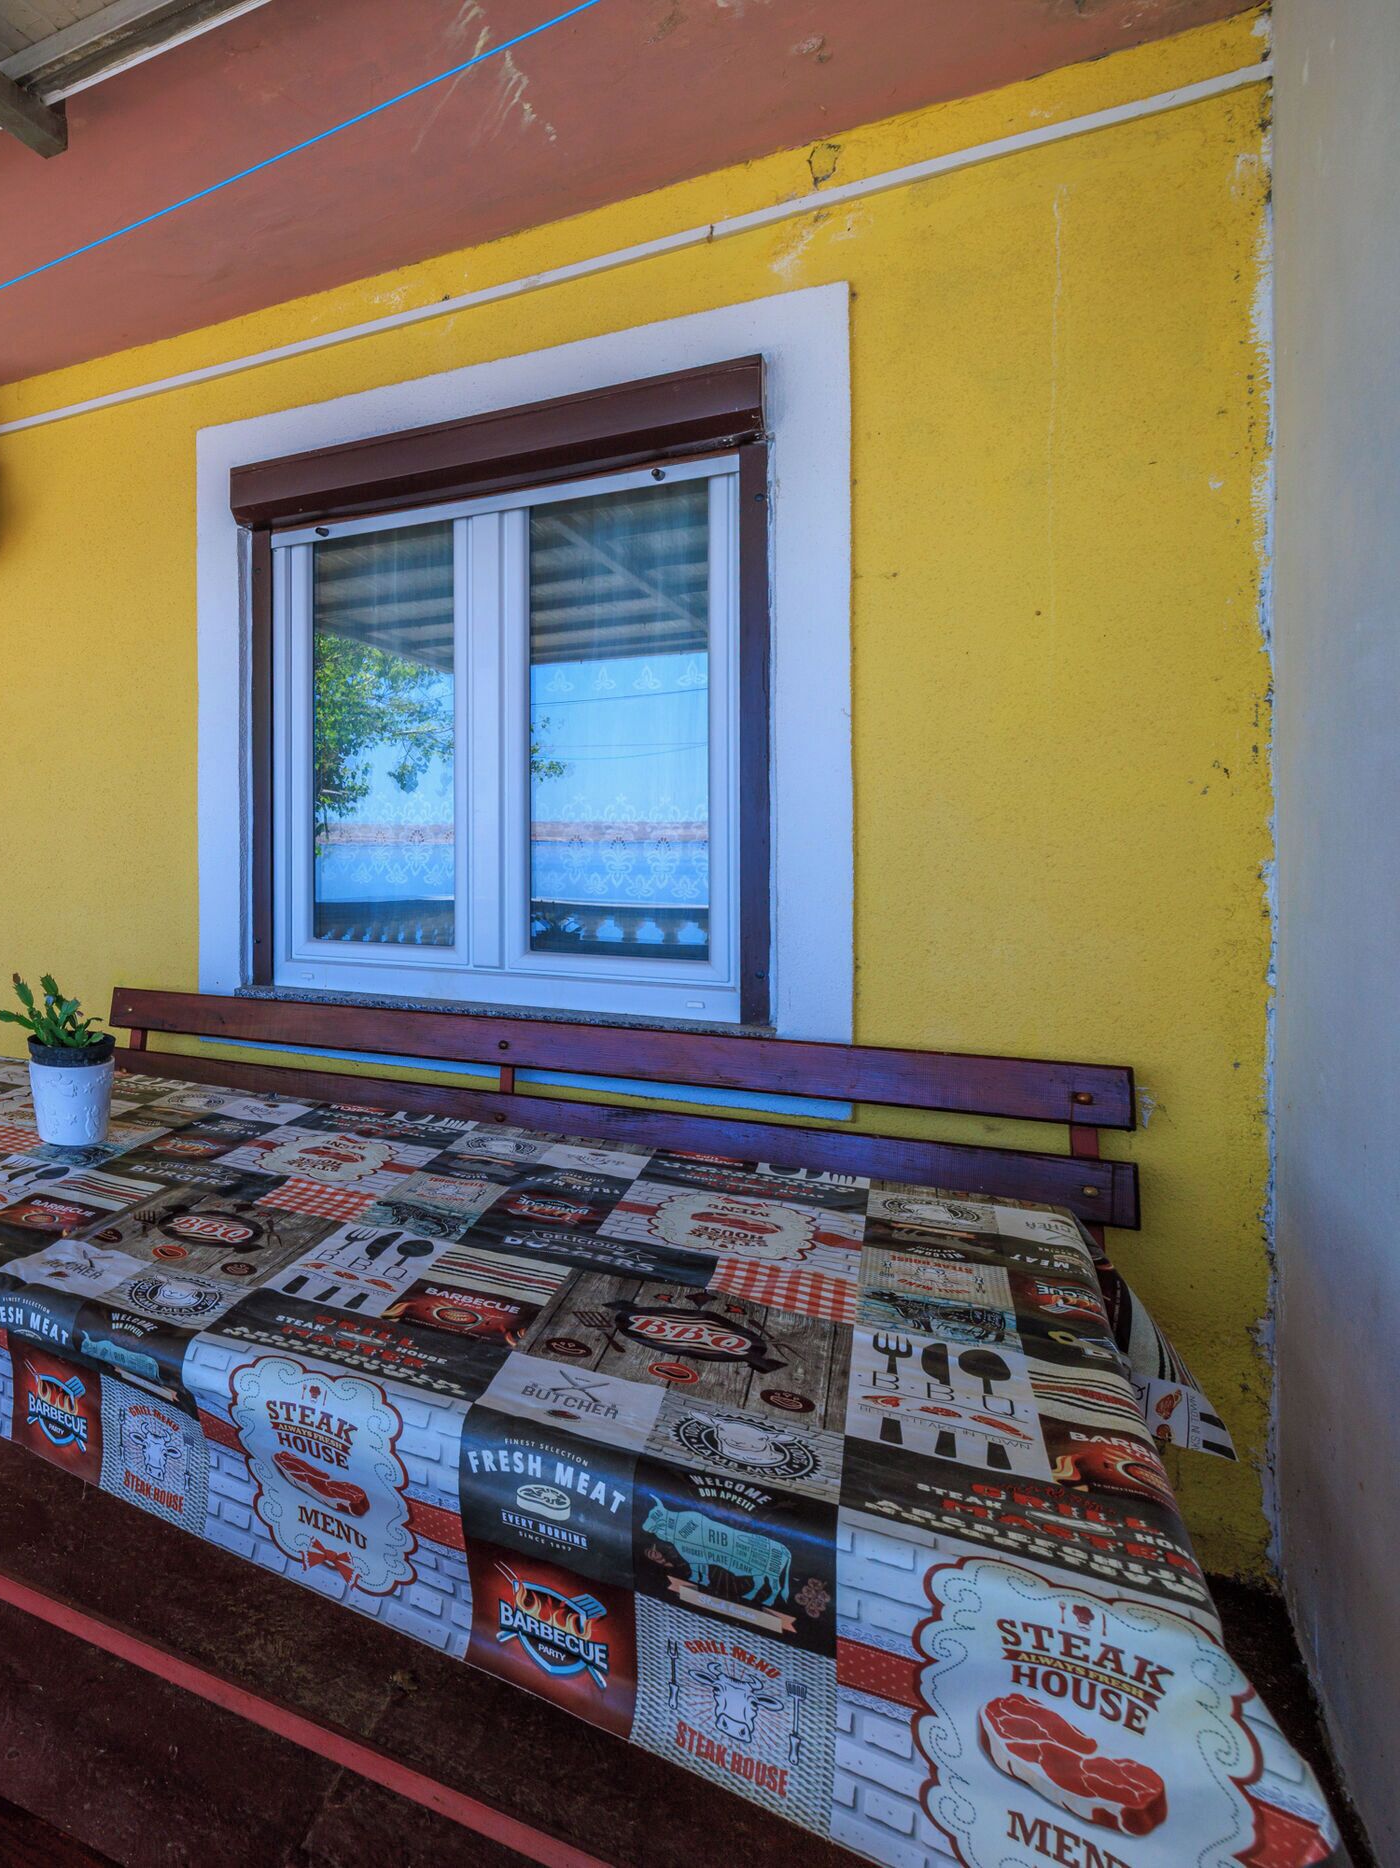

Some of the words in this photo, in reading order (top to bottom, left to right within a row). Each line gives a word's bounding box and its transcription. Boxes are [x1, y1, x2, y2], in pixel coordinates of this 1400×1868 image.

[130, 1165, 235, 1186] BURGERS
[165, 1163, 222, 1174] DELICIOUS
[30, 1200, 97, 1217] BARBECUE
[708, 1203, 770, 1217] MENU
[167, 1215, 254, 1243] BBQ
[542, 1232, 626, 1251] DELICIOUS
[889, 1254, 930, 1267] HOUSE
[932, 1260, 974, 1275] STEAK
[1010, 1253, 1071, 1270] MEAT
[22, 1299, 50, 1315] SELECTION
[425, 1287, 521, 1314] BARBECUE
[30, 1312, 69, 1345] MEAT
[111, 1312, 161, 1332] WELCOME
[276, 1315, 326, 1332] STEAK
[628, 1315, 752, 1355] BBQ
[396, 1346, 448, 1365] HOUSE
[28, 1391, 89, 1439] BARBECUE
[129, 1404, 152, 1418] GRILL
[153, 1409, 180, 1433] MENU
[266, 1400, 358, 1446] STEAK
[48, 1423, 65, 1436] PARTY
[279, 1423, 313, 1439] ALWAYS
[313, 1434, 343, 1450] FRESH
[901, 1415, 957, 1433] STEAKS
[962, 1428, 976, 1438] IN
[985, 1434, 1032, 1450] TOWN
[277, 1432, 349, 1471] HOUSE
[505, 1438, 535, 1447] FINEST
[540, 1443, 589, 1467] SELECTION
[694, 1443, 739, 1469] LAMB
[746, 1465, 794, 1476] MEAT
[123, 1468, 152, 1496] STEAK
[153, 1488, 185, 1514] HOUSE
[468, 1449, 542, 1479] FRESH
[555, 1462, 626, 1514] MEAT
[689, 1475, 772, 1505] WELCOME
[699, 1487, 717, 1498] BON
[720, 1490, 756, 1512] APPETIT
[917, 1483, 1002, 1511] STEAK
[298, 1506, 367, 1550] MENU
[502, 1512, 534, 1529] EVERY
[539, 1523, 588, 1547] MORNING
[519, 1531, 545, 1544] SINCE
[678, 1520, 700, 1539] CHUCK
[708, 1528, 729, 1548] RIB
[707, 1551, 729, 1566] PLATE
[731, 1559, 752, 1574] FLANK
[499, 1600, 609, 1671] BARBECUE
[538, 1643, 566, 1663] PARTY
[684, 1639, 728, 1657] GRILL
[732, 1644, 782, 1680] MENU
[997, 1618, 1175, 1696] STEAK
[1018, 1652, 1088, 1677] ALWAYS
[1088, 1671, 1147, 1699] FRESH
[1011, 1664, 1150, 1737] HOUSE
[676, 1720, 727, 1770] STEAK
[731, 1750, 790, 1798] HOUSE
